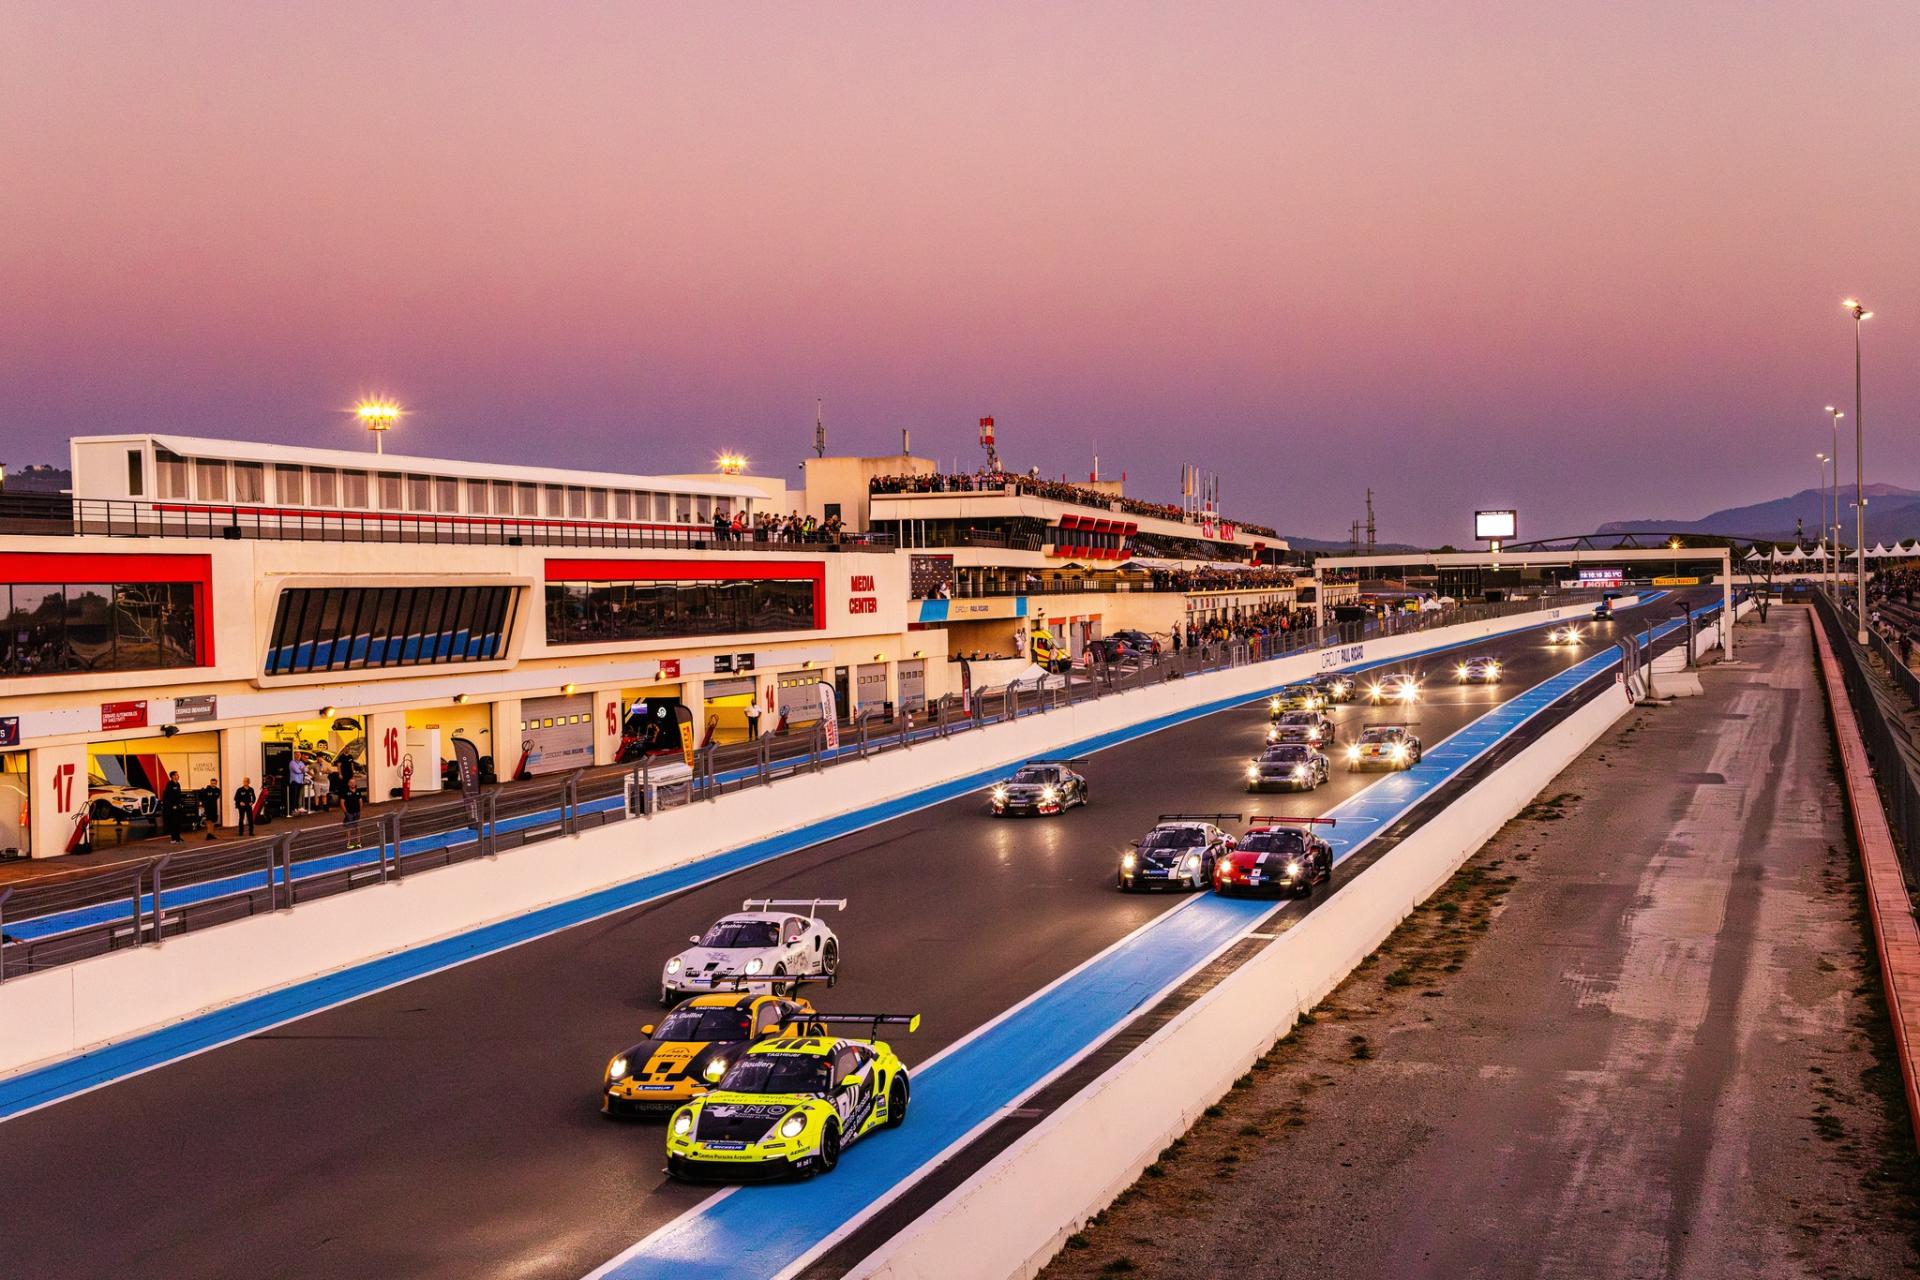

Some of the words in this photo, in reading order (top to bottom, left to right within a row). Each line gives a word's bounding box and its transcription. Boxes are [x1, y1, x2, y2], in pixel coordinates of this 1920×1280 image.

[851, 576, 875, 592] MEDIA
[849, 597, 877, 614] CENTER
[766, 684, 775, 714] 14
[606, 702, 617, 736] 15
[384, 727, 399, 767] 16
[53, 763, 75, 814] 17
